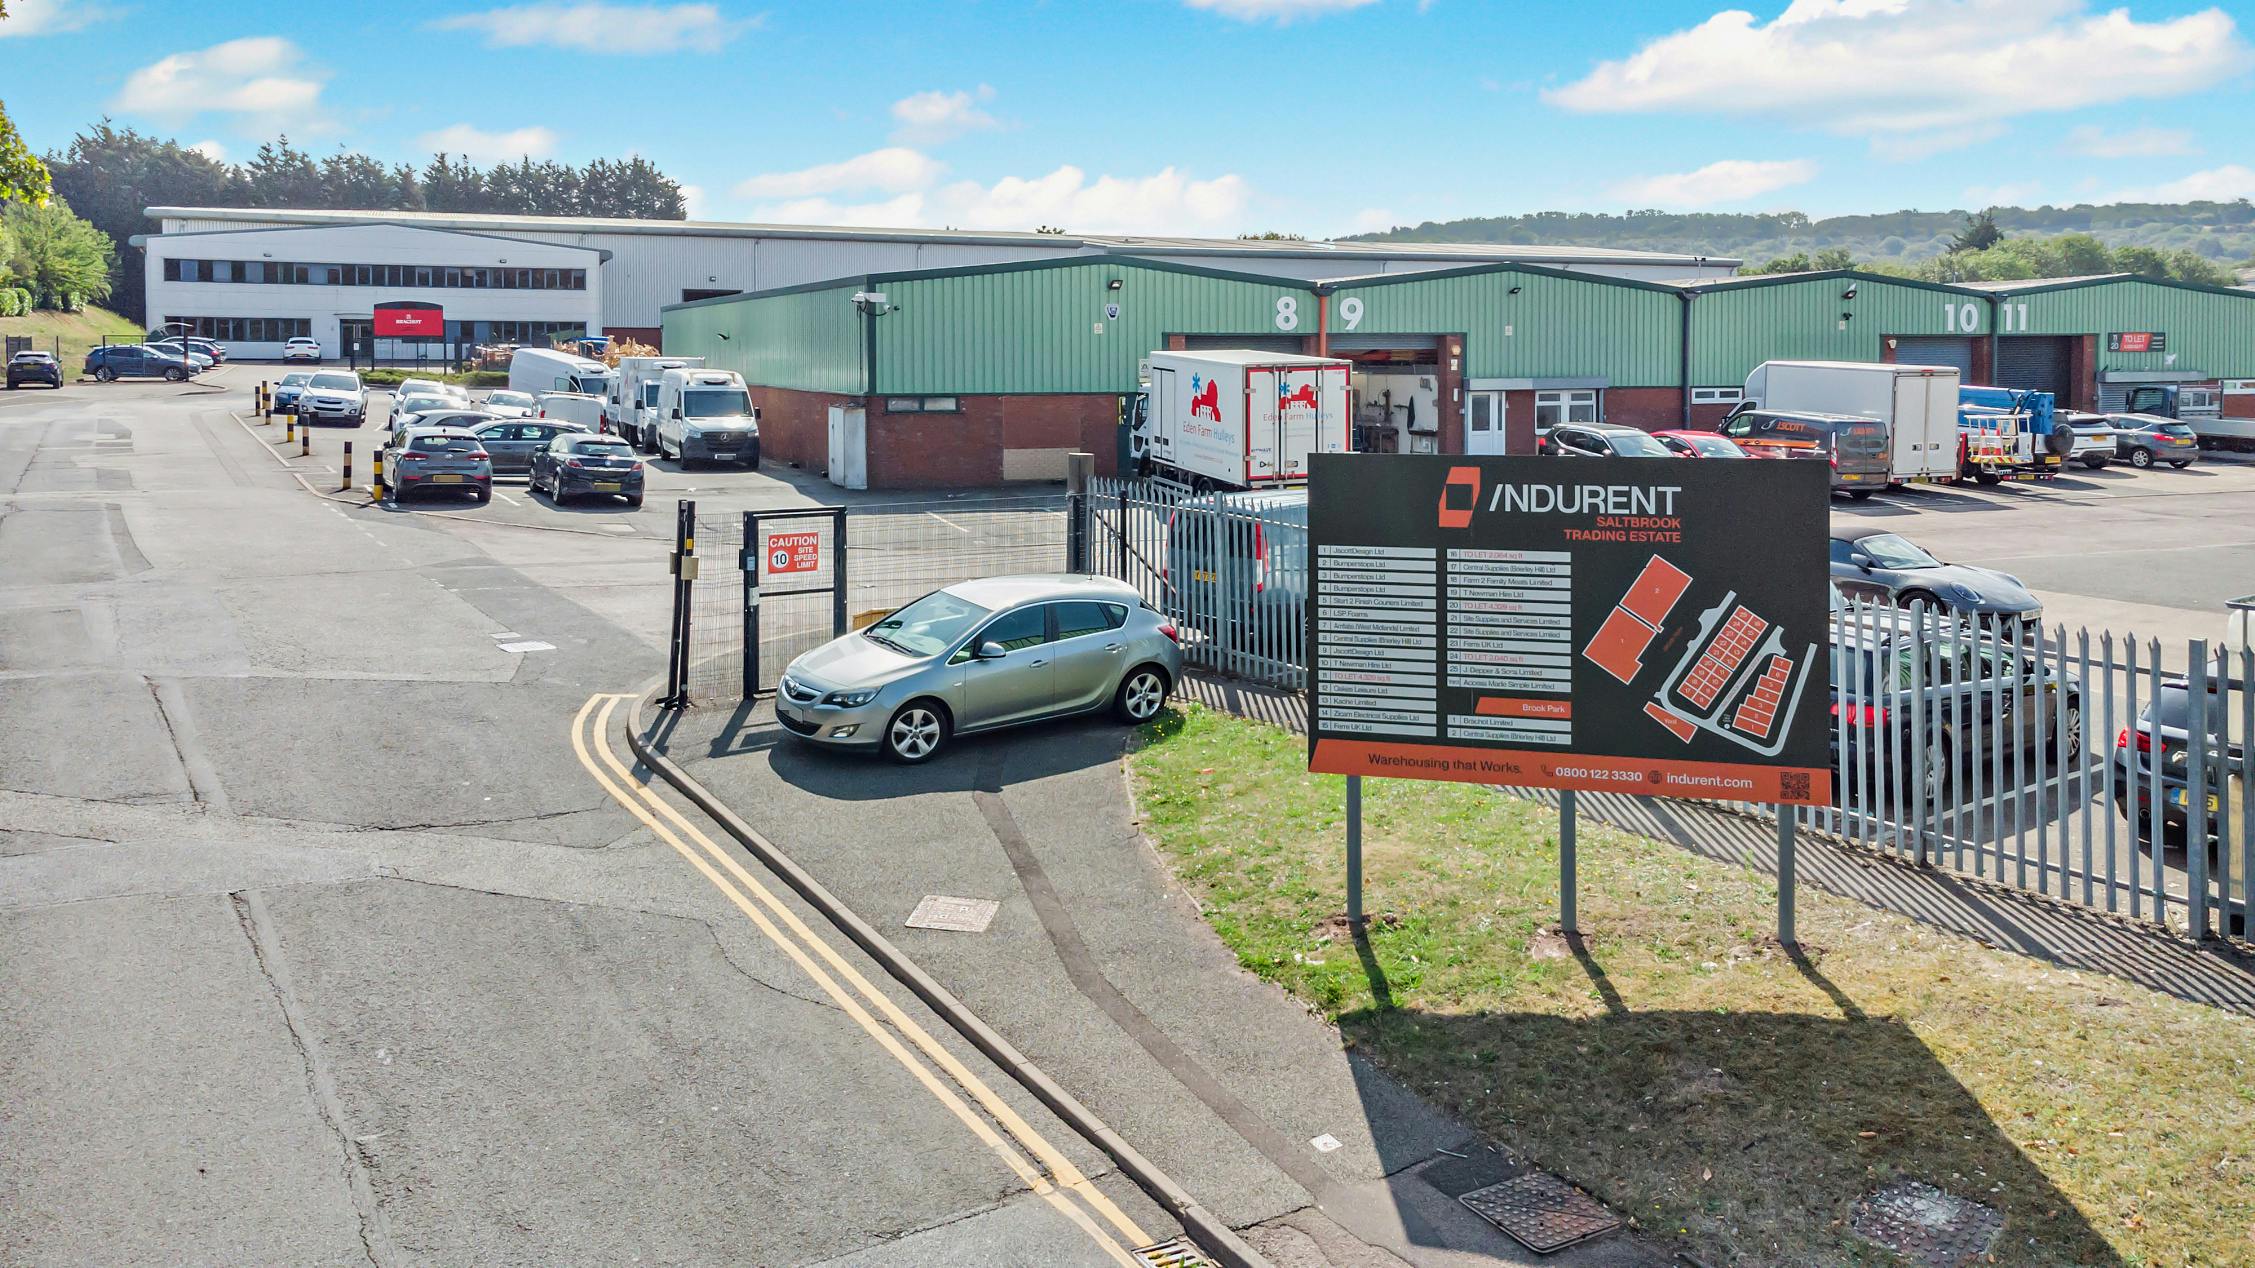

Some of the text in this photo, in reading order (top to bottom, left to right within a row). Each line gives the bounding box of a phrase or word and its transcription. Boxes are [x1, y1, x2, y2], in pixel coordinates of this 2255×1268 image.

[1275, 296, 1298, 330] 8
[1340, 297, 1364, 330] 9
[1945, 303, 1978, 332] 10
[2004, 304, 2026, 331] 11
[1264, 413, 1282, 421] Eden
[1183, 421, 1235, 445] Eden Farm Hulleys
[1596, 516, 1681, 529] SALTBROOK
[770, 536, 817, 547] CAUTION
[1564, 529, 1681, 543] TRADING ESTATE
[774, 554, 787, 565] 10
[1508, 681, 1530, 689] Simple
[1522, 704, 1545, 712] Brook
[1490, 718, 1513, 726] Limited
[1368, 753, 1449, 771] Warehousing
[1453, 759, 1477, 771] that
[1555, 767, 1642, 781] 0800 122 3330
[1667, 773, 1753, 788] indurent.com
